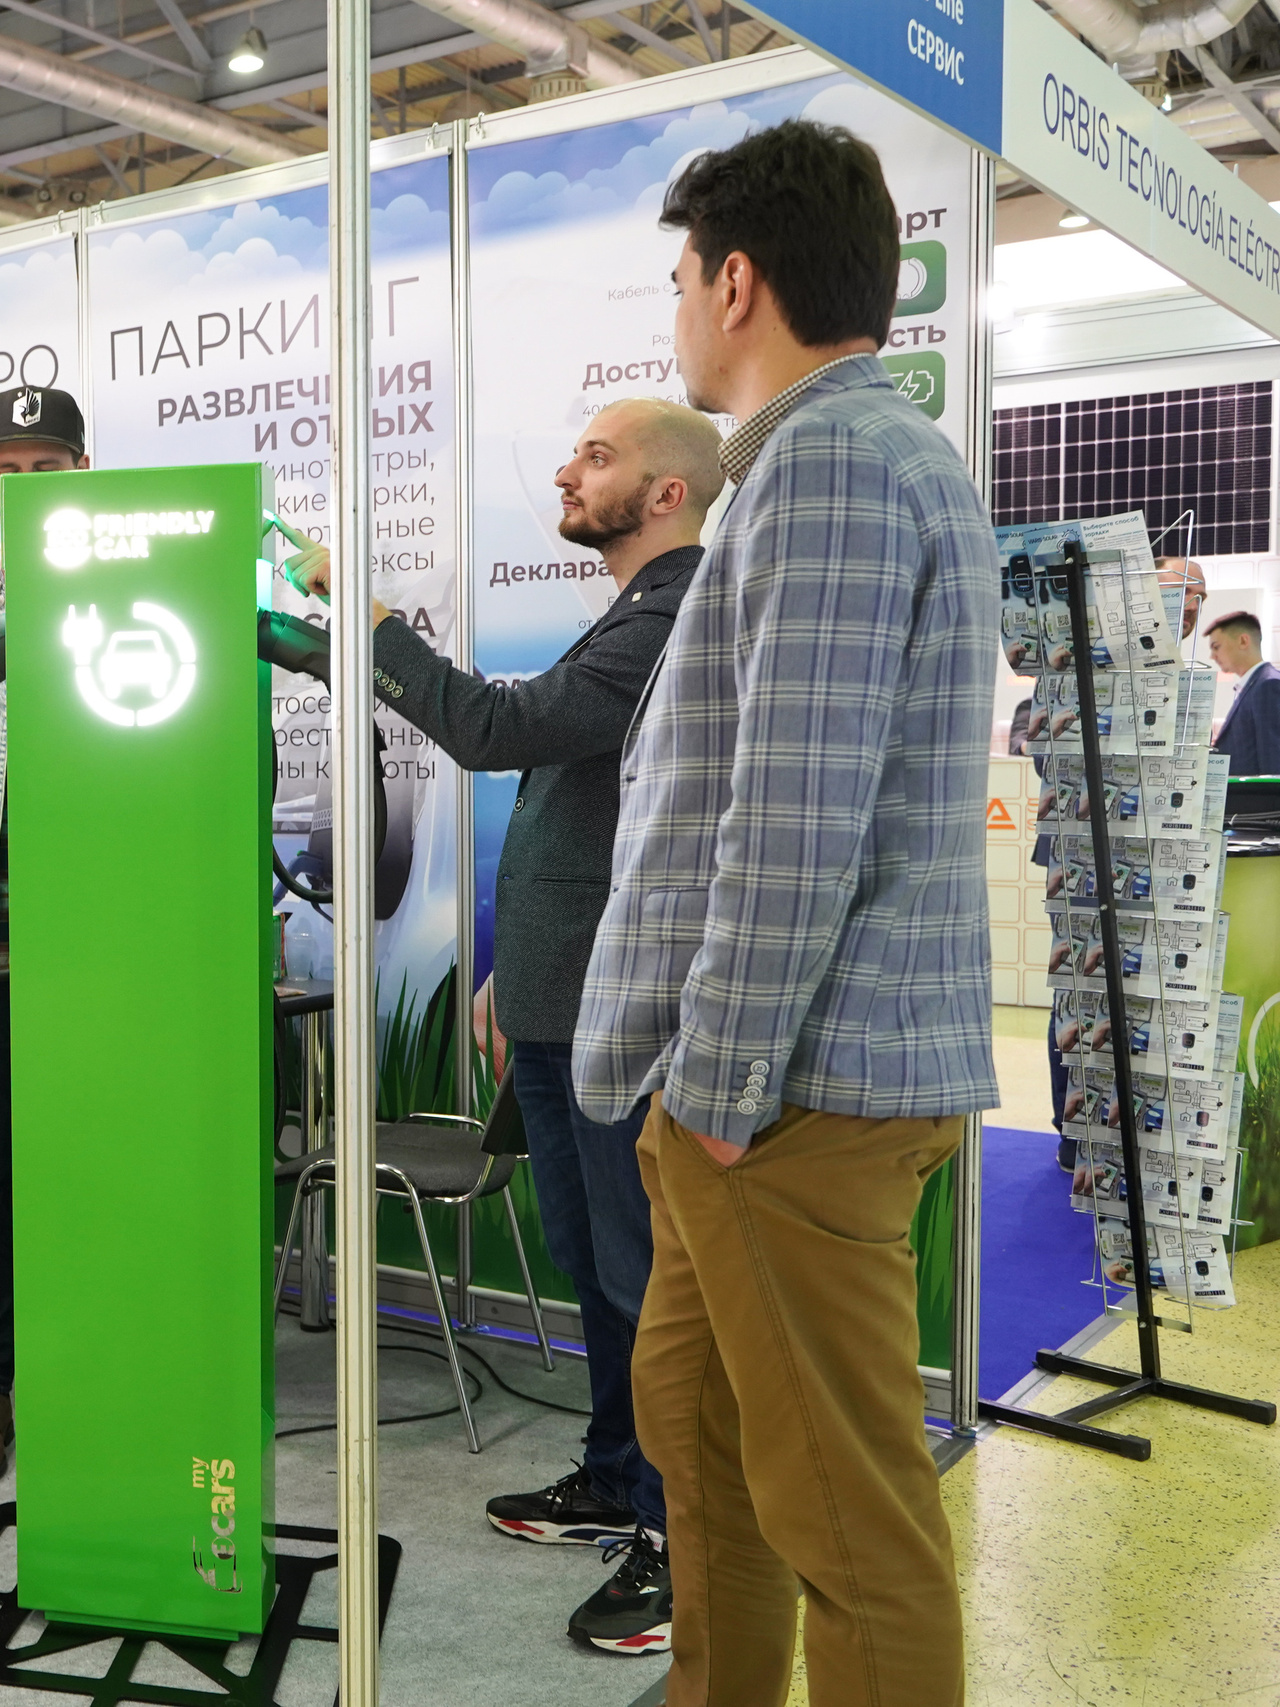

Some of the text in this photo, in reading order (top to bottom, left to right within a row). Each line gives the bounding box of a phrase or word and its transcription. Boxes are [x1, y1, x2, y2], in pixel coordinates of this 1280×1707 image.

[907, 18, 965, 86] СЕРВИС
[1043, 73, 1110, 170] ORBIS
[1116, 124, 1225, 256] TECNOLOGÍA
[608, 285, 659, 301] Кабель
[110, 276, 420, 381] ПАРКИГ
[652, 334, 677, 347] Роз
[887, 325, 947, 348] сть
[582, 358, 681, 391] Досту
[158, 360, 432, 427] РАЗВЛЕЧИЯ
[254, 401, 435, 453] И ОТЫХ
[277, 483, 435, 515] кие рки,
[93, 510, 215, 538] FRIENDLY
[93, 536, 150, 561] CAR
[489, 559, 614, 587] Деклара
[192, 1456, 210, 1489] my
